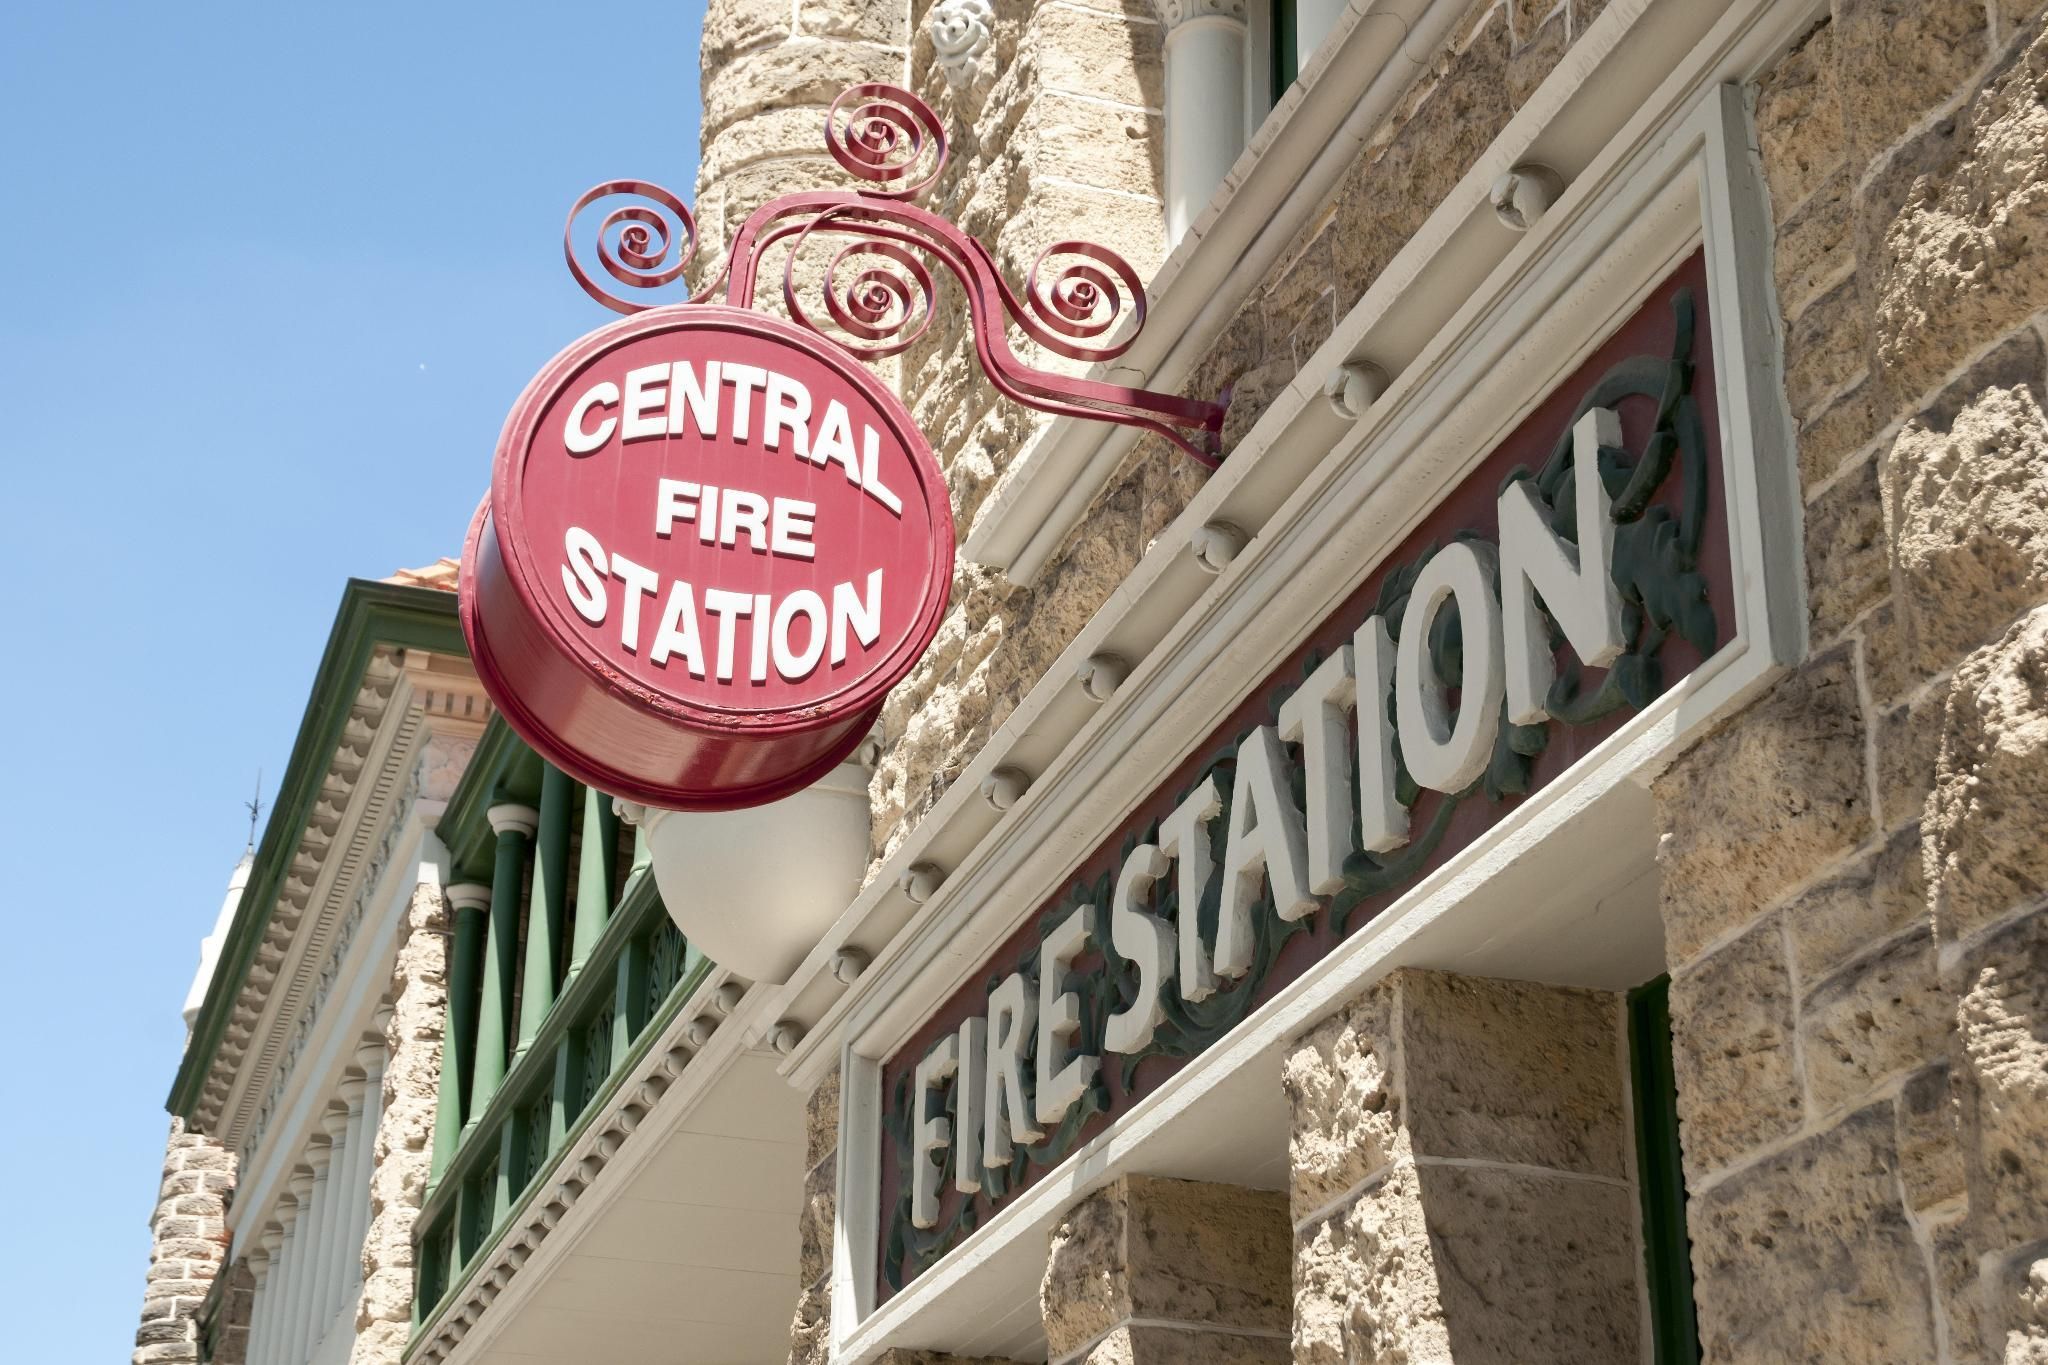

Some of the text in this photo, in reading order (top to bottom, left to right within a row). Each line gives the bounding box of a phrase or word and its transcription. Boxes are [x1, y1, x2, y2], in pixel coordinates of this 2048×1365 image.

[564, 360, 902, 518] CENTRAL
[656, 478, 816, 562] FIRE
[561, 526, 883, 686] STATION
[912, 407, 1626, 1229] FIRE STATION
